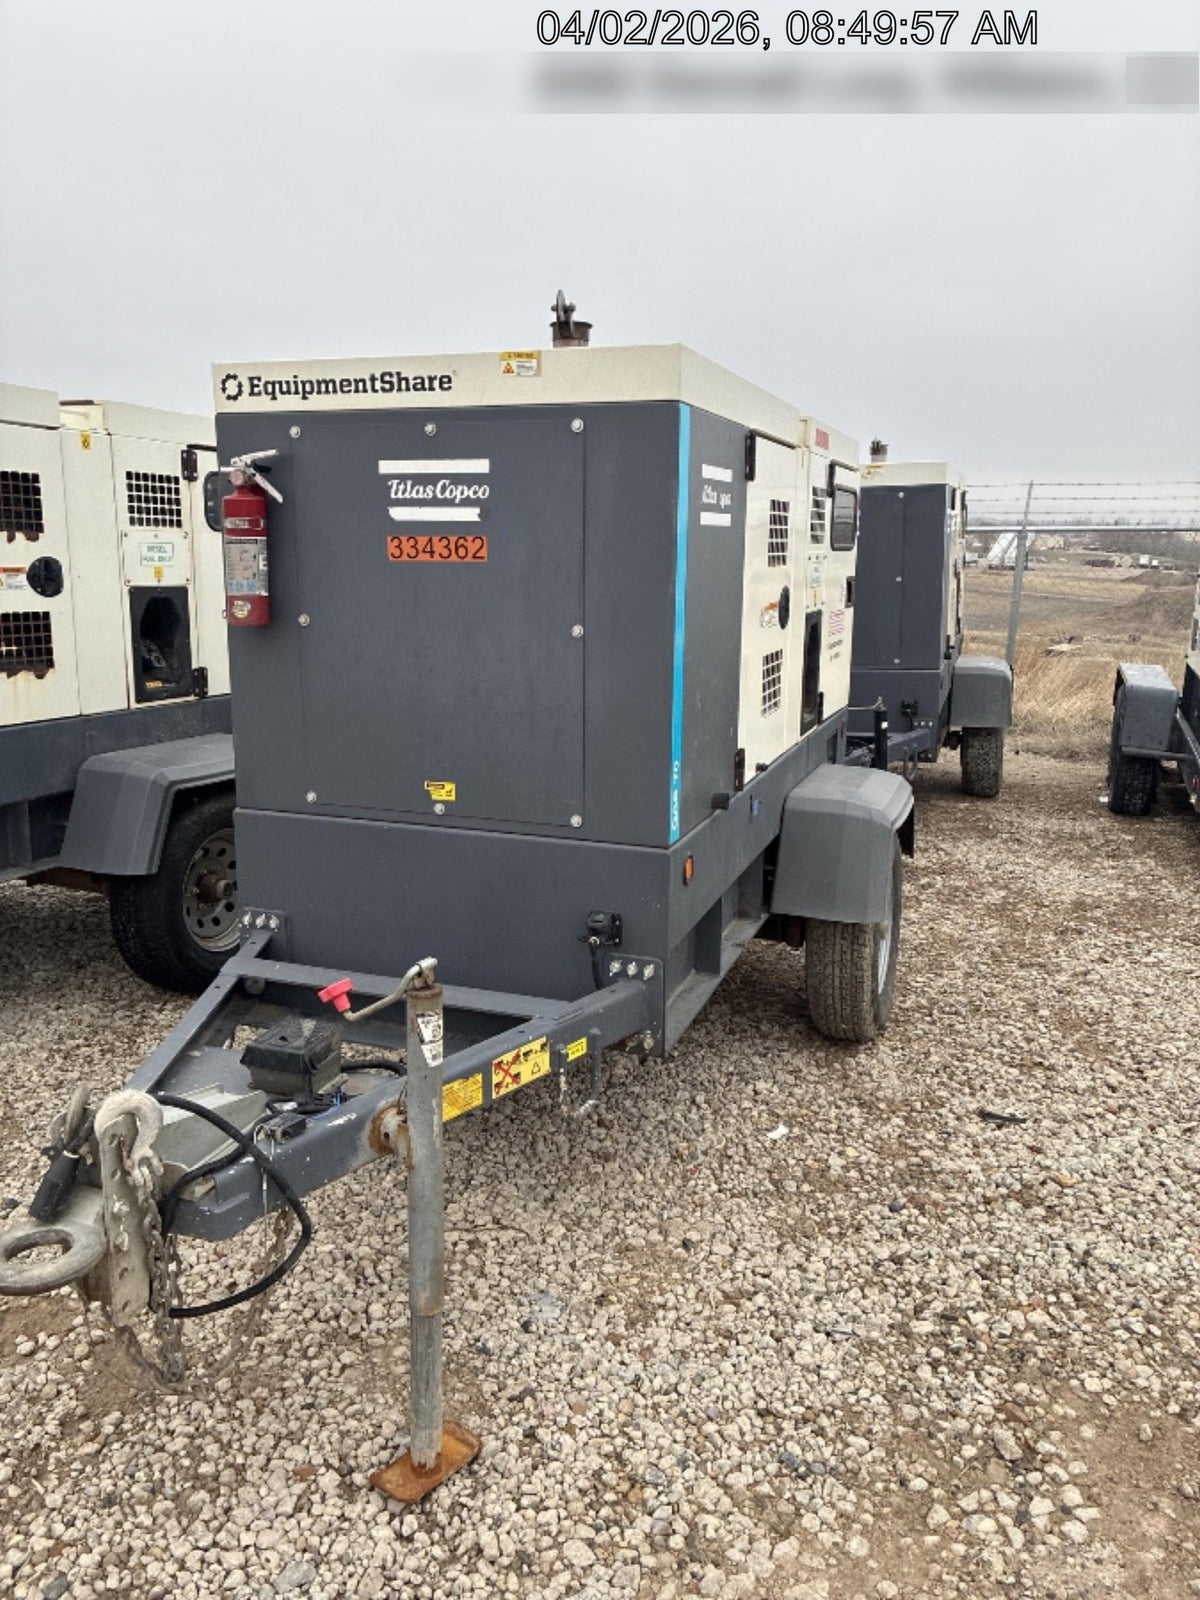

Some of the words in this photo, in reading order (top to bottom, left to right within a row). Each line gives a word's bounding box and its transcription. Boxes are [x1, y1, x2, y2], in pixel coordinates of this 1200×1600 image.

[247, 371, 453, 401] EquipmentShare
[435, 479, 490, 504] Copco
[390, 535, 485, 560] 334362
